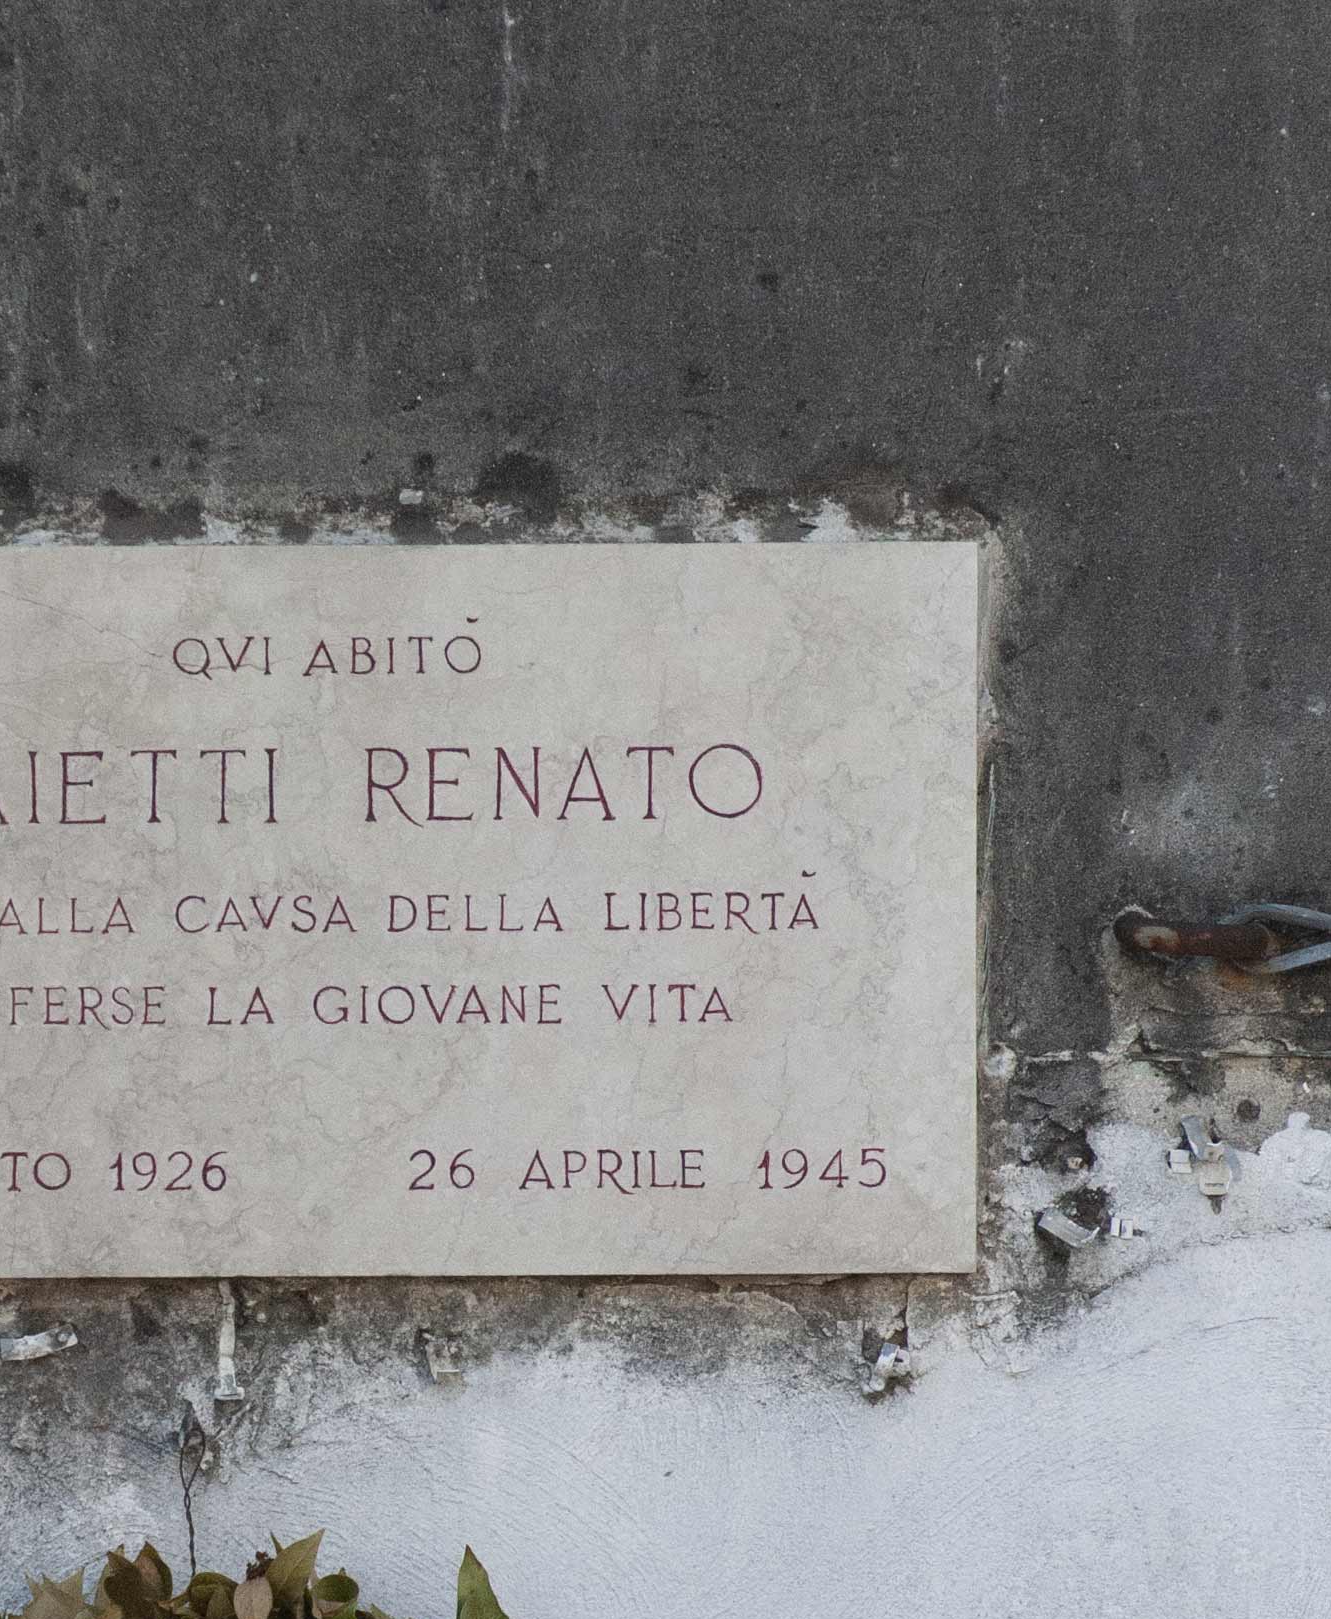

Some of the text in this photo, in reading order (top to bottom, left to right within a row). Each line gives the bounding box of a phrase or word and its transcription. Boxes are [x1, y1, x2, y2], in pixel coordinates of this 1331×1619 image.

[171, 635, 272, 681] QVI
[364, 742, 764, 827] RENATO
[174, 894, 357, 935] CAVSA
[387, 893, 564, 934] DELLA
[206, 985, 275, 1026] LA
[312, 983, 563, 1026] GIOVANE
[601, 983, 734, 1026] VITA
[109, 1150, 228, 1193] 1926
[408, 1148, 476, 1192] 26
[518, 1148, 706, 1196] APRILE
[756, 1147, 887, 1191] 1945
